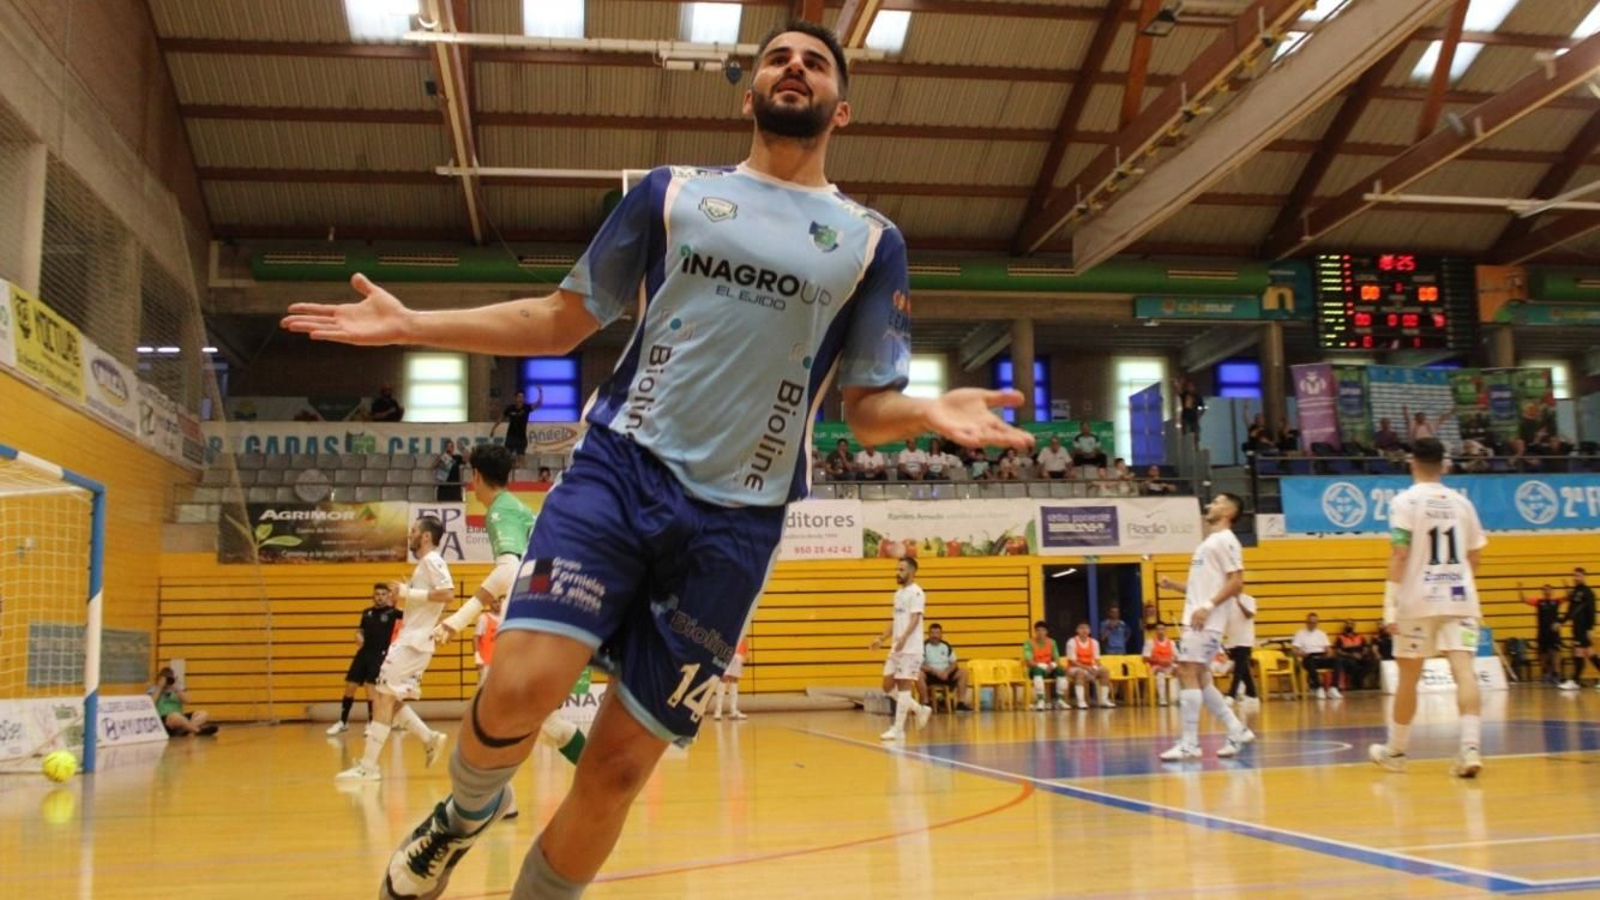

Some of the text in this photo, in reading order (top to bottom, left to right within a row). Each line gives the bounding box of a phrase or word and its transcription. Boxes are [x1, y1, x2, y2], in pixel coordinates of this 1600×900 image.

[715, 284, 787, 311] EL EJIDO
[745, 379, 804, 491] Bioline
[259, 509, 356, 521] AGRIMOR
[827, 545, 838, 553] 42
[841, 545, 852, 553] 42
[1428, 526, 1459, 565] 11
[551, 557, 581, 572] Grupo
[550, 581, 563, 596] &
[667, 663, 721, 722] 14
